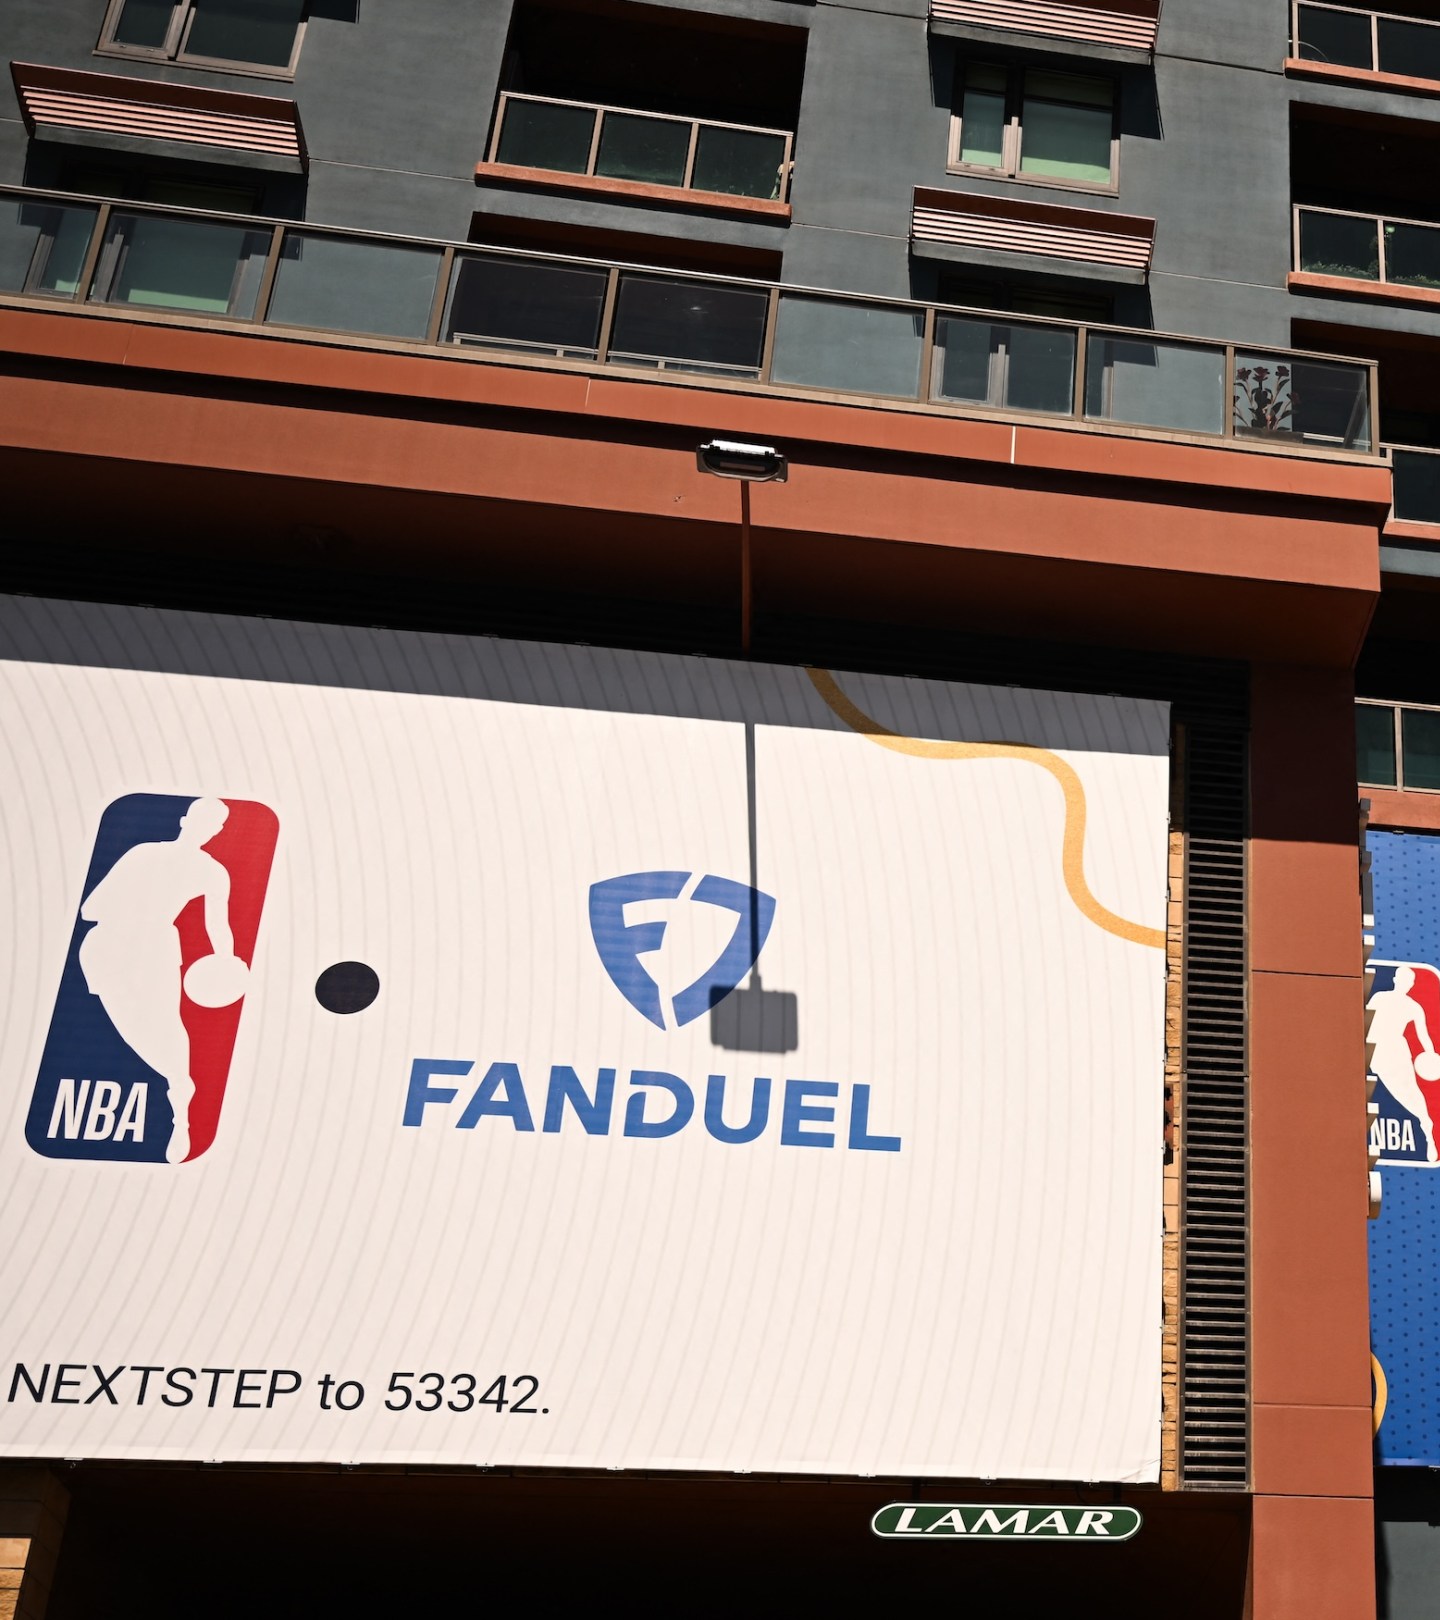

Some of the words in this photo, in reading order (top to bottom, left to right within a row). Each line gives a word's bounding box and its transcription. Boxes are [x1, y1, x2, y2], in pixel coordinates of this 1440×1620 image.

[46, 1079, 150, 1143] NBA
[402, 1058, 902, 1152] FANDUEL
[1370, 1117, 1416, 1152] NBA
[7, 1363, 302, 1408] NEXTSTEP
[318, 1374, 365, 1410] to
[384, 1372, 550, 1414] 53342.
[894, 1507, 1114, 1535] LAMAR
